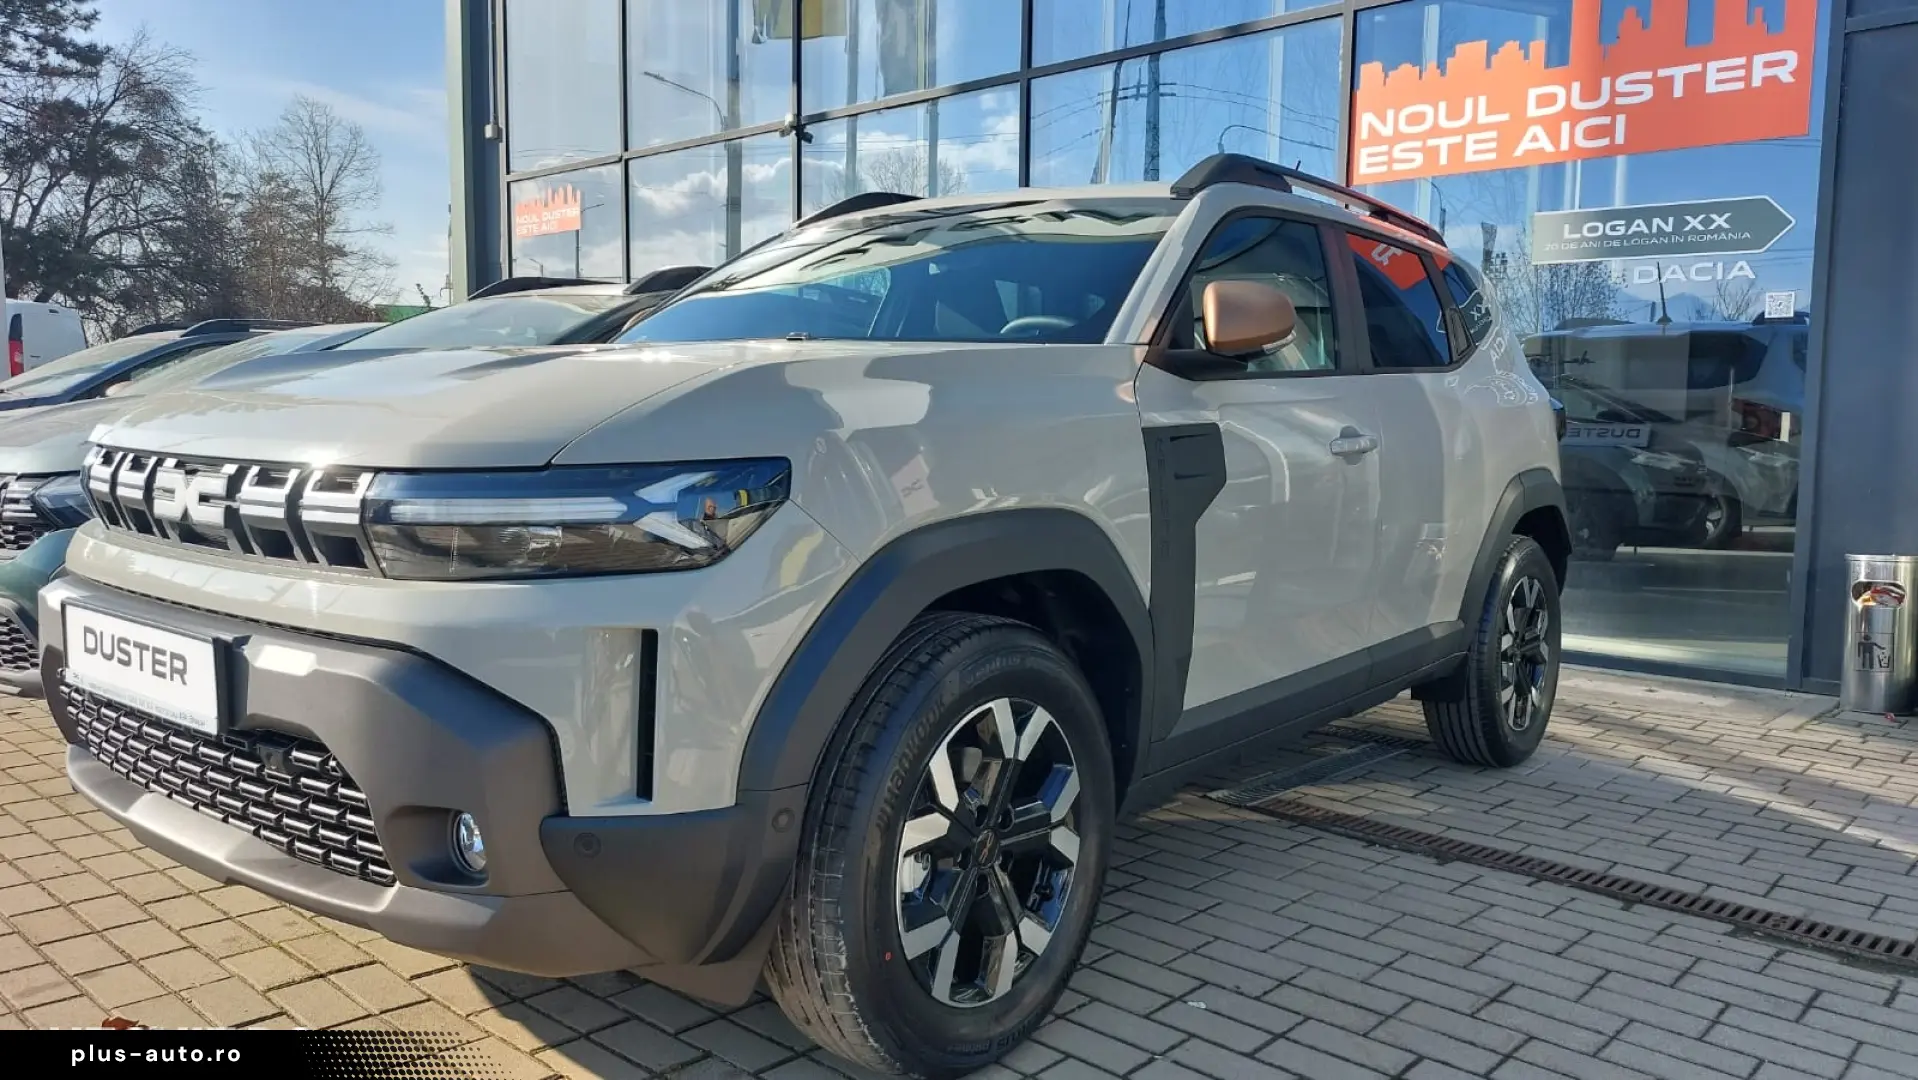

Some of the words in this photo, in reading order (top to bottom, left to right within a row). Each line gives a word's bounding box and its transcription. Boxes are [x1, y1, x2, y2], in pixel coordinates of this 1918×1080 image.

[1360, 95, 1509, 140] NOUL
[1526, 49, 1798, 118] DUSTER
[1358, 130, 1498, 175] ESTE
[1512, 113, 1626, 158] AICI
[1561, 241, 1578, 250] DE
[1580, 240, 1600, 249] ANI
[1603, 239, 1621, 248] DE
[1623, 237, 1669, 246] LOGAN
[1563, 216, 1675, 239] LOGAN
[1683, 212, 1732, 231] XX
[1633, 260, 1756, 284] DACIA
[83, 625, 188, 686] DUSTER
